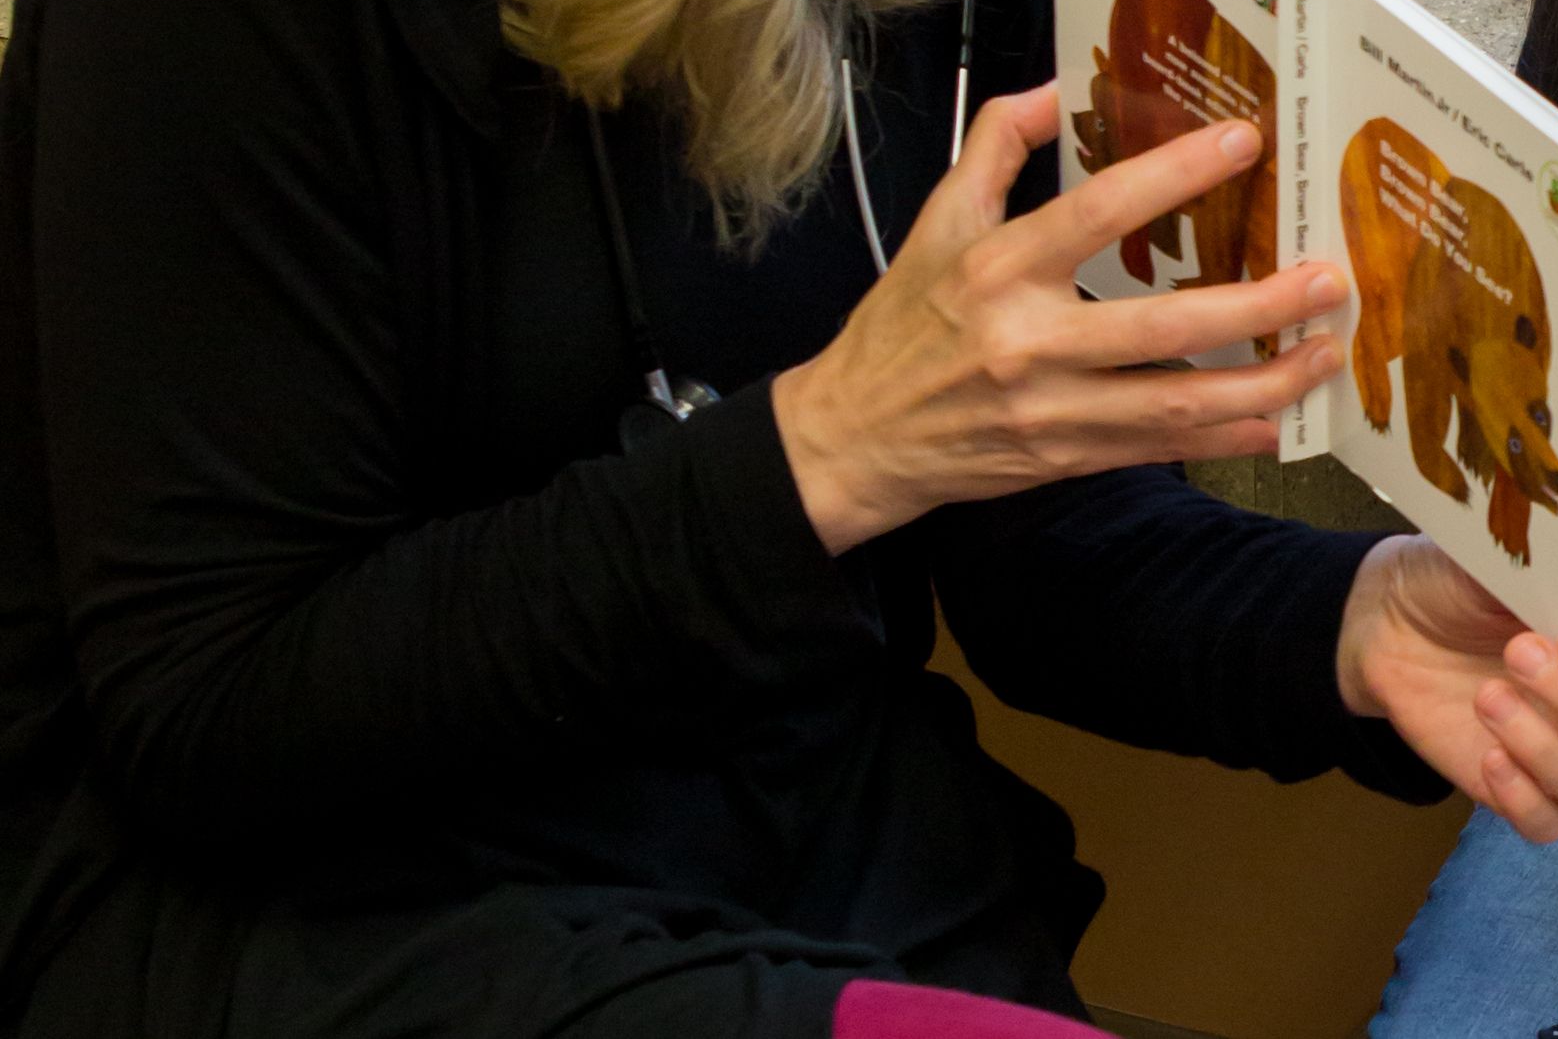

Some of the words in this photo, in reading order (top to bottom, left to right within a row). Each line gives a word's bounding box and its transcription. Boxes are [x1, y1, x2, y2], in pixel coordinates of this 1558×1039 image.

[1164, 51, 1189, 72] now
[1189, 68, 1238, 107] available
[1239, 101, 1251, 117] in
[1167, 35, 1178, 48] A
[1178, 41, 1221, 78] beloved
[1296, 43, 1309, 80] Carle
[1296, 96, 1309, 139] Brown
[1359, 35, 1384, 63] Bill
[1388, 57, 1435, 104] Martin
[1462, 114, 1490, 149] Eric
[1494, 142, 1534, 183] Carle
[1296, 179, 1309, 222] Brown
[1380, 139, 1427, 188] Brown
[1429, 178, 1469, 225] Bear,
[1380, 163, 1427, 212] Brown
[1429, 203, 1469, 249] Bear,
[1379, 186, 1417, 230] What
[1419, 220, 1441, 248] Do
[1443, 238, 1473, 274] You
[1474, 265, 1514, 306] See?
